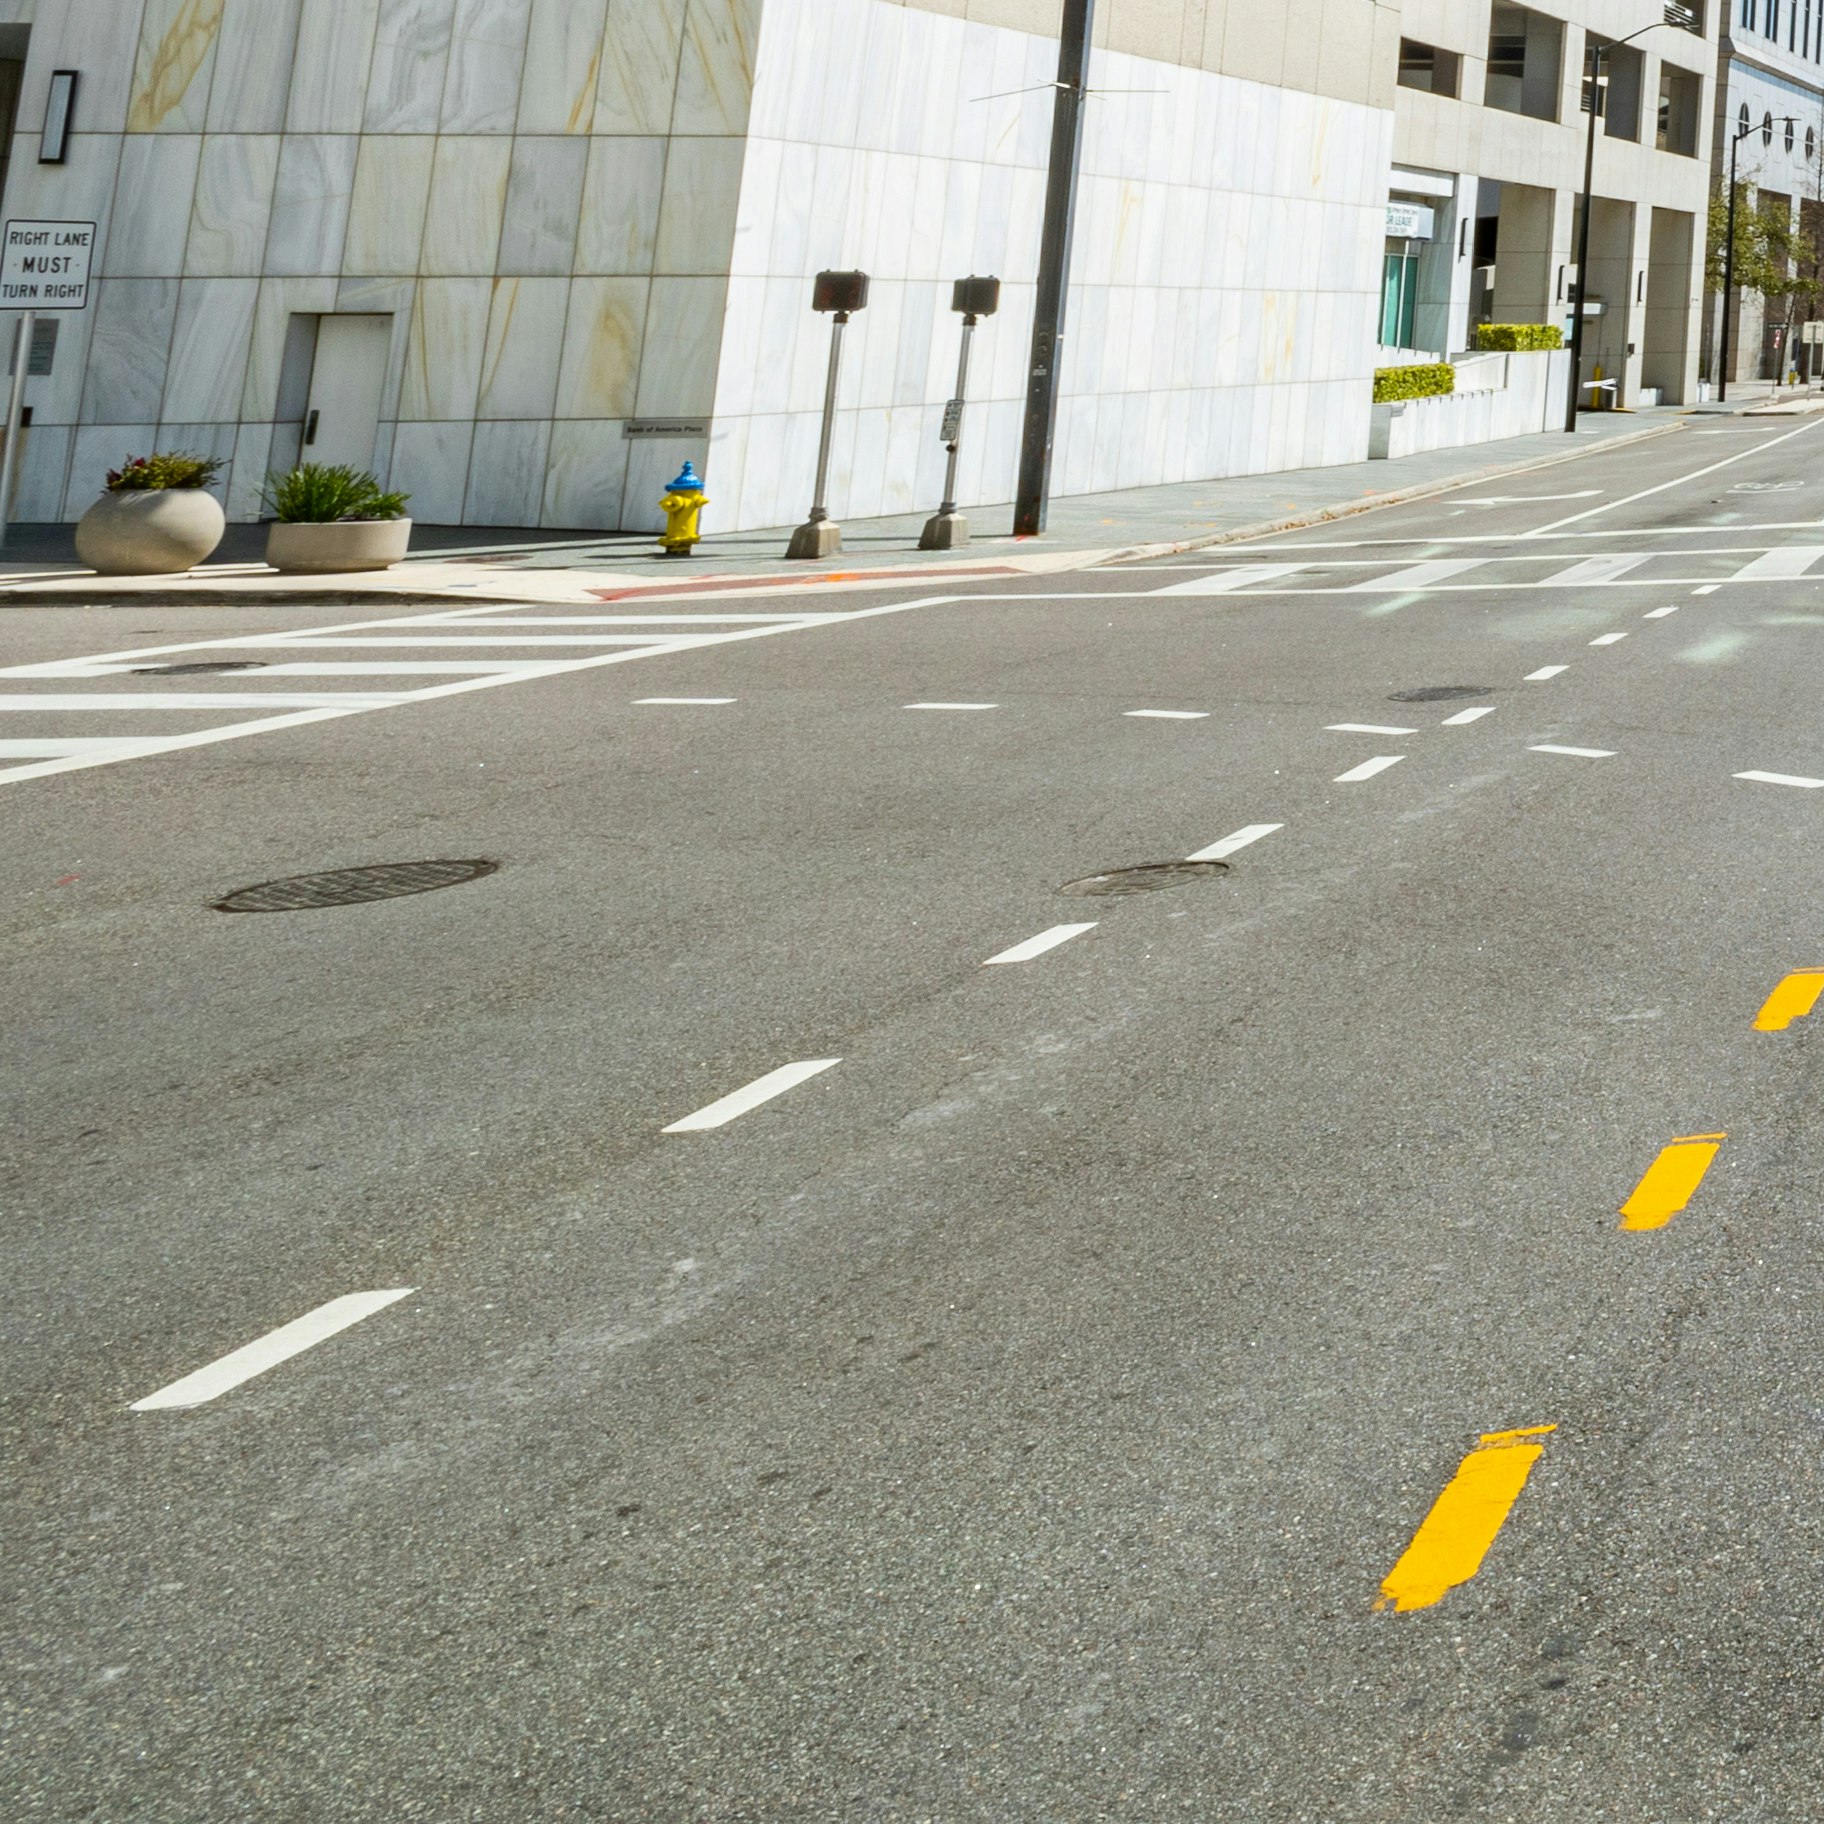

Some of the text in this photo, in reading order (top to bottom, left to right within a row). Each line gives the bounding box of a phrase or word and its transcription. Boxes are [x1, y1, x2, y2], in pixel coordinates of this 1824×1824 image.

[9, 231, 90, 246] RIGHT LANE
[22, 256, 72, 273] MUST
[3, 284, 84, 298] TURN RIGHT
